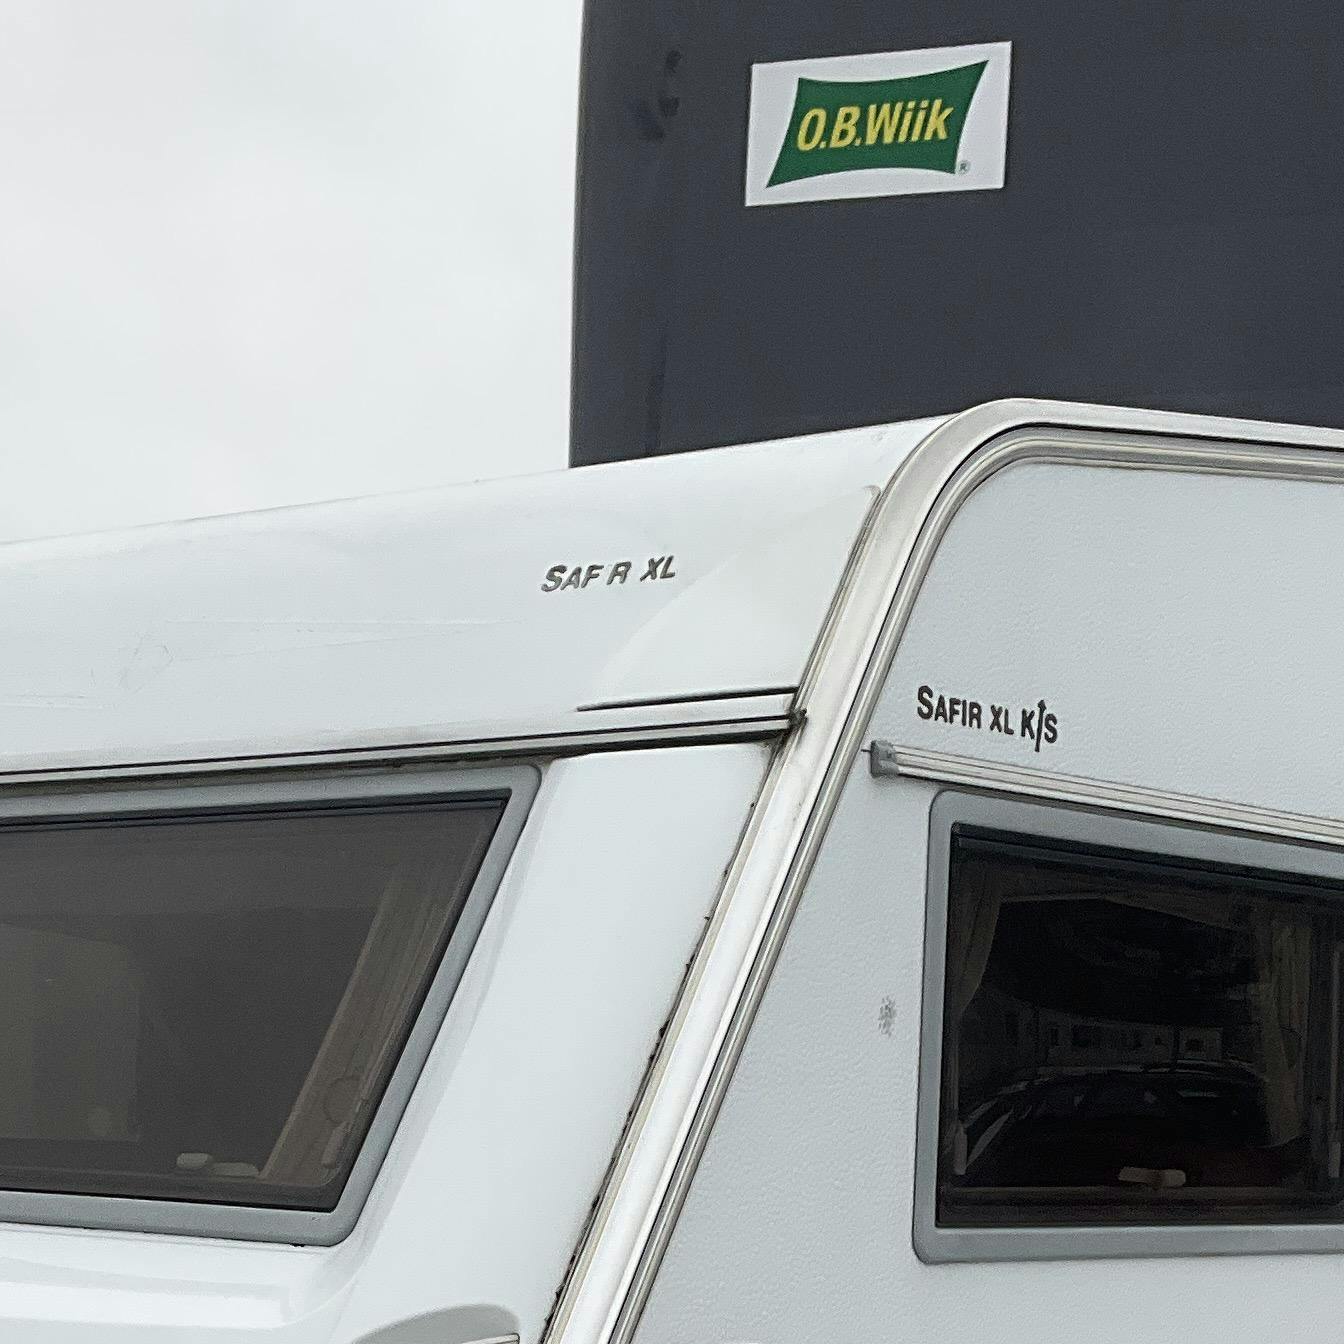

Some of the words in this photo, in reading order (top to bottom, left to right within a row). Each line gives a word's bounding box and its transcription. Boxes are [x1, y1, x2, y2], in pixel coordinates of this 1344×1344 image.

[796, 98, 955, 152] O.B.Wiik
[639, 554, 676, 582] XL
[916, 684, 982, 730] SAFIR
[989, 703, 1015, 736] XL
